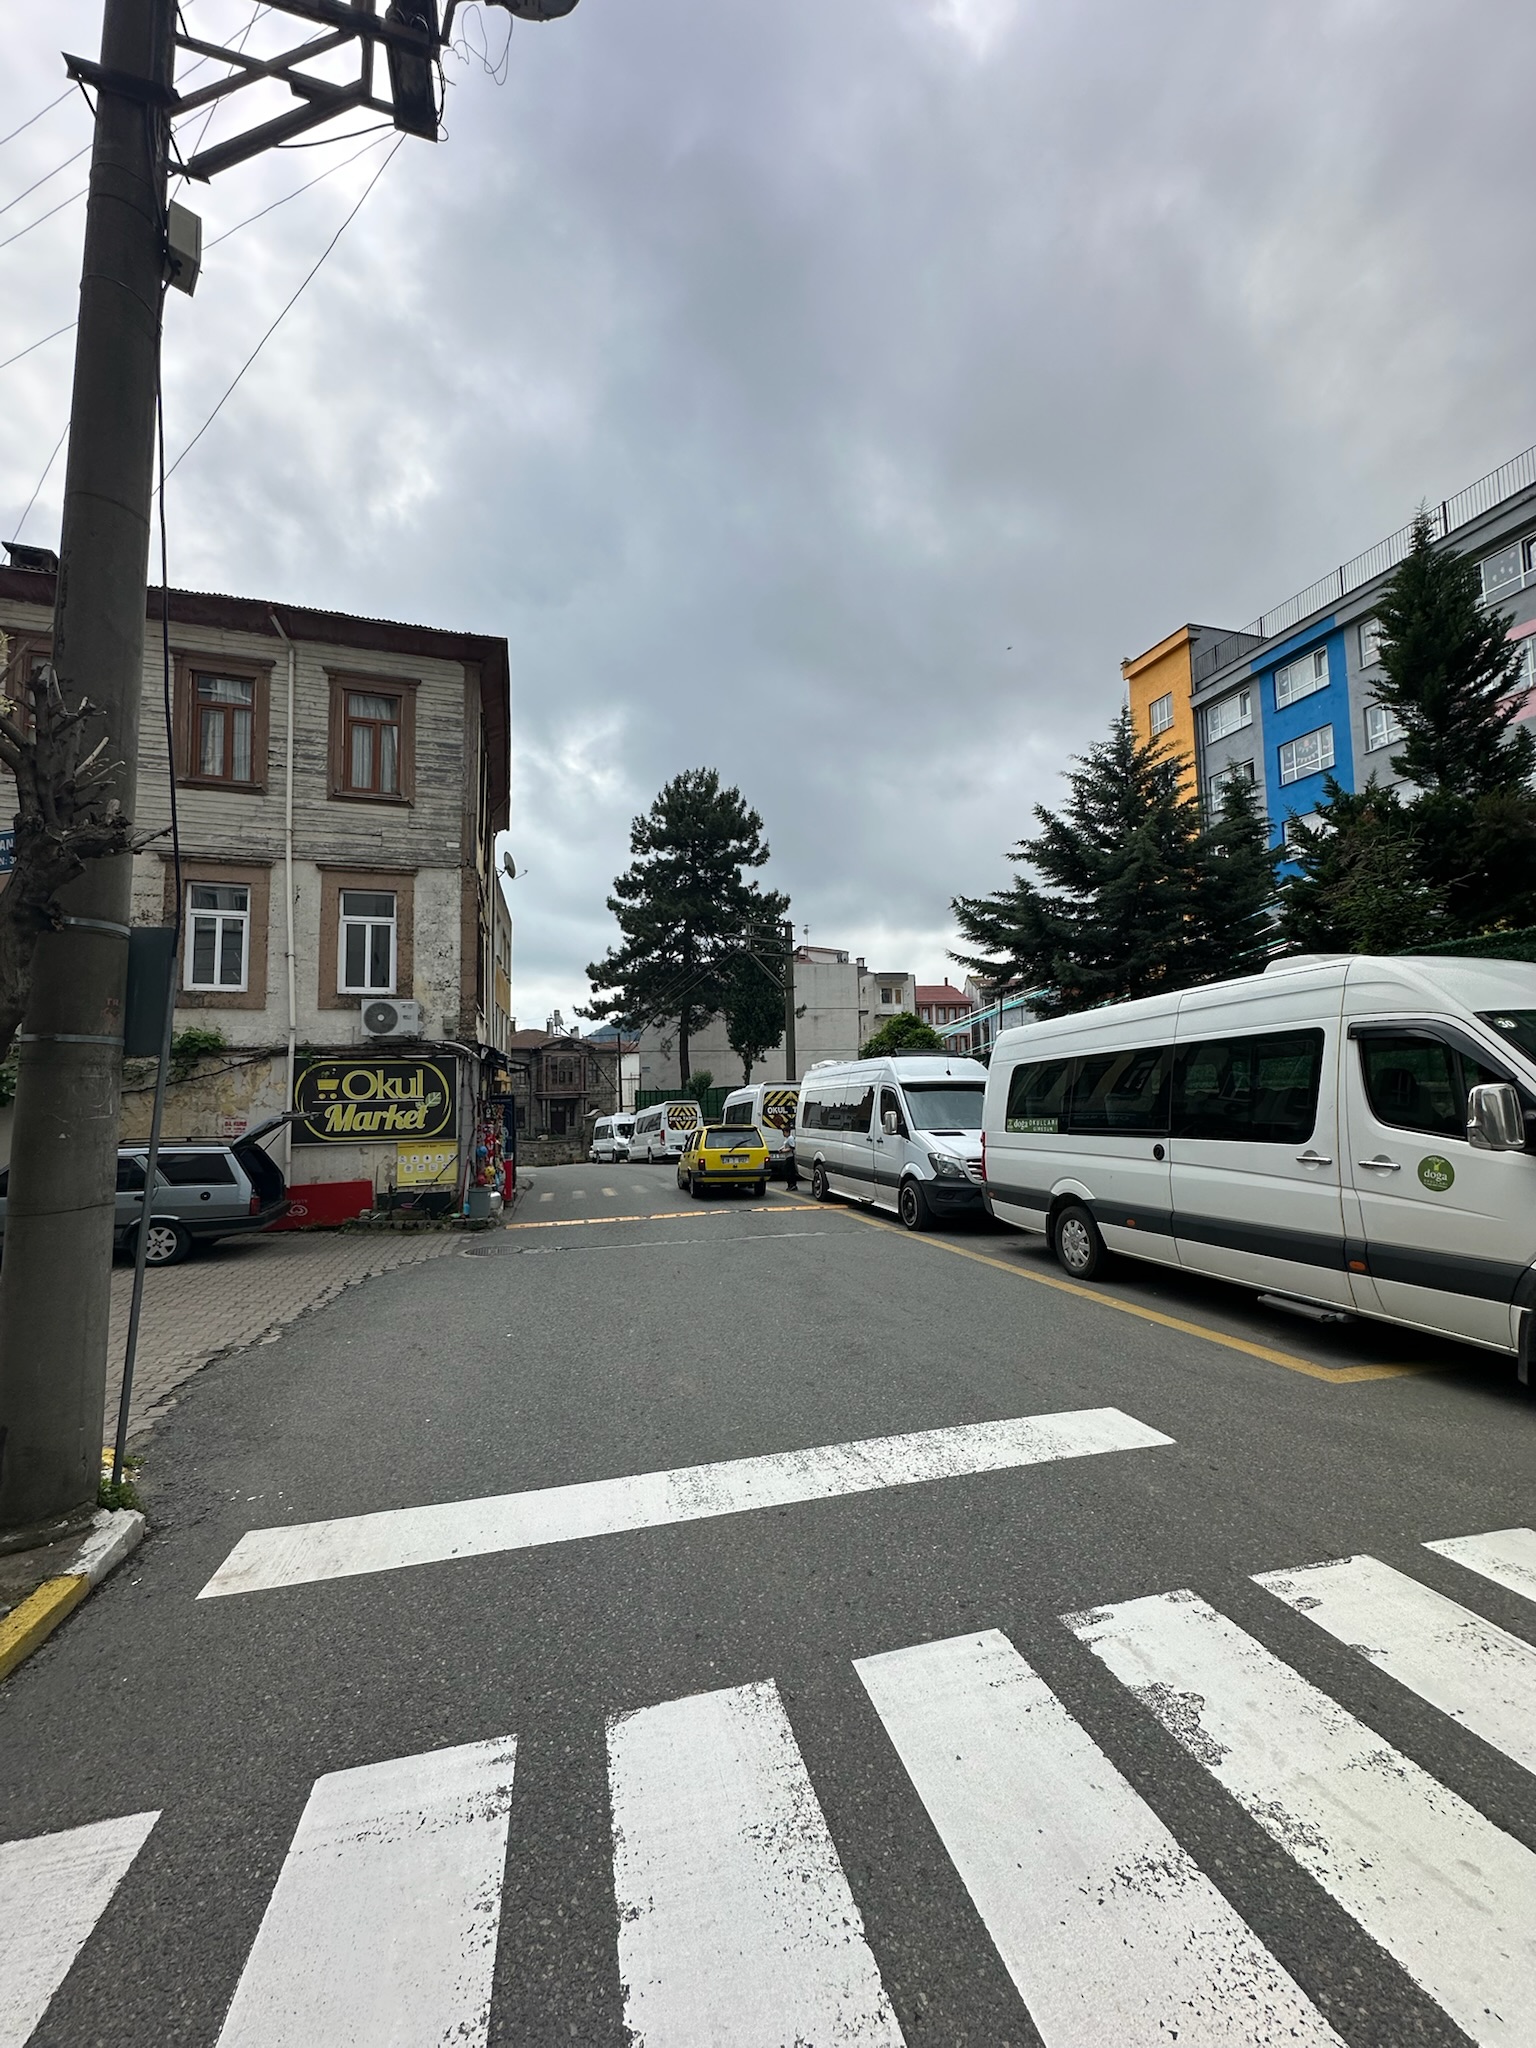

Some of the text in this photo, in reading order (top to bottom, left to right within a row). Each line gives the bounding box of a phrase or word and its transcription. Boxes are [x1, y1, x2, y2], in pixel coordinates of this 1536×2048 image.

[1497, 1020, 1516, 1028] 30
[341, 1069, 425, 1100] Okul
[324, 1103, 429, 1132] Market
[767, 1106, 788, 1114] OKUL
